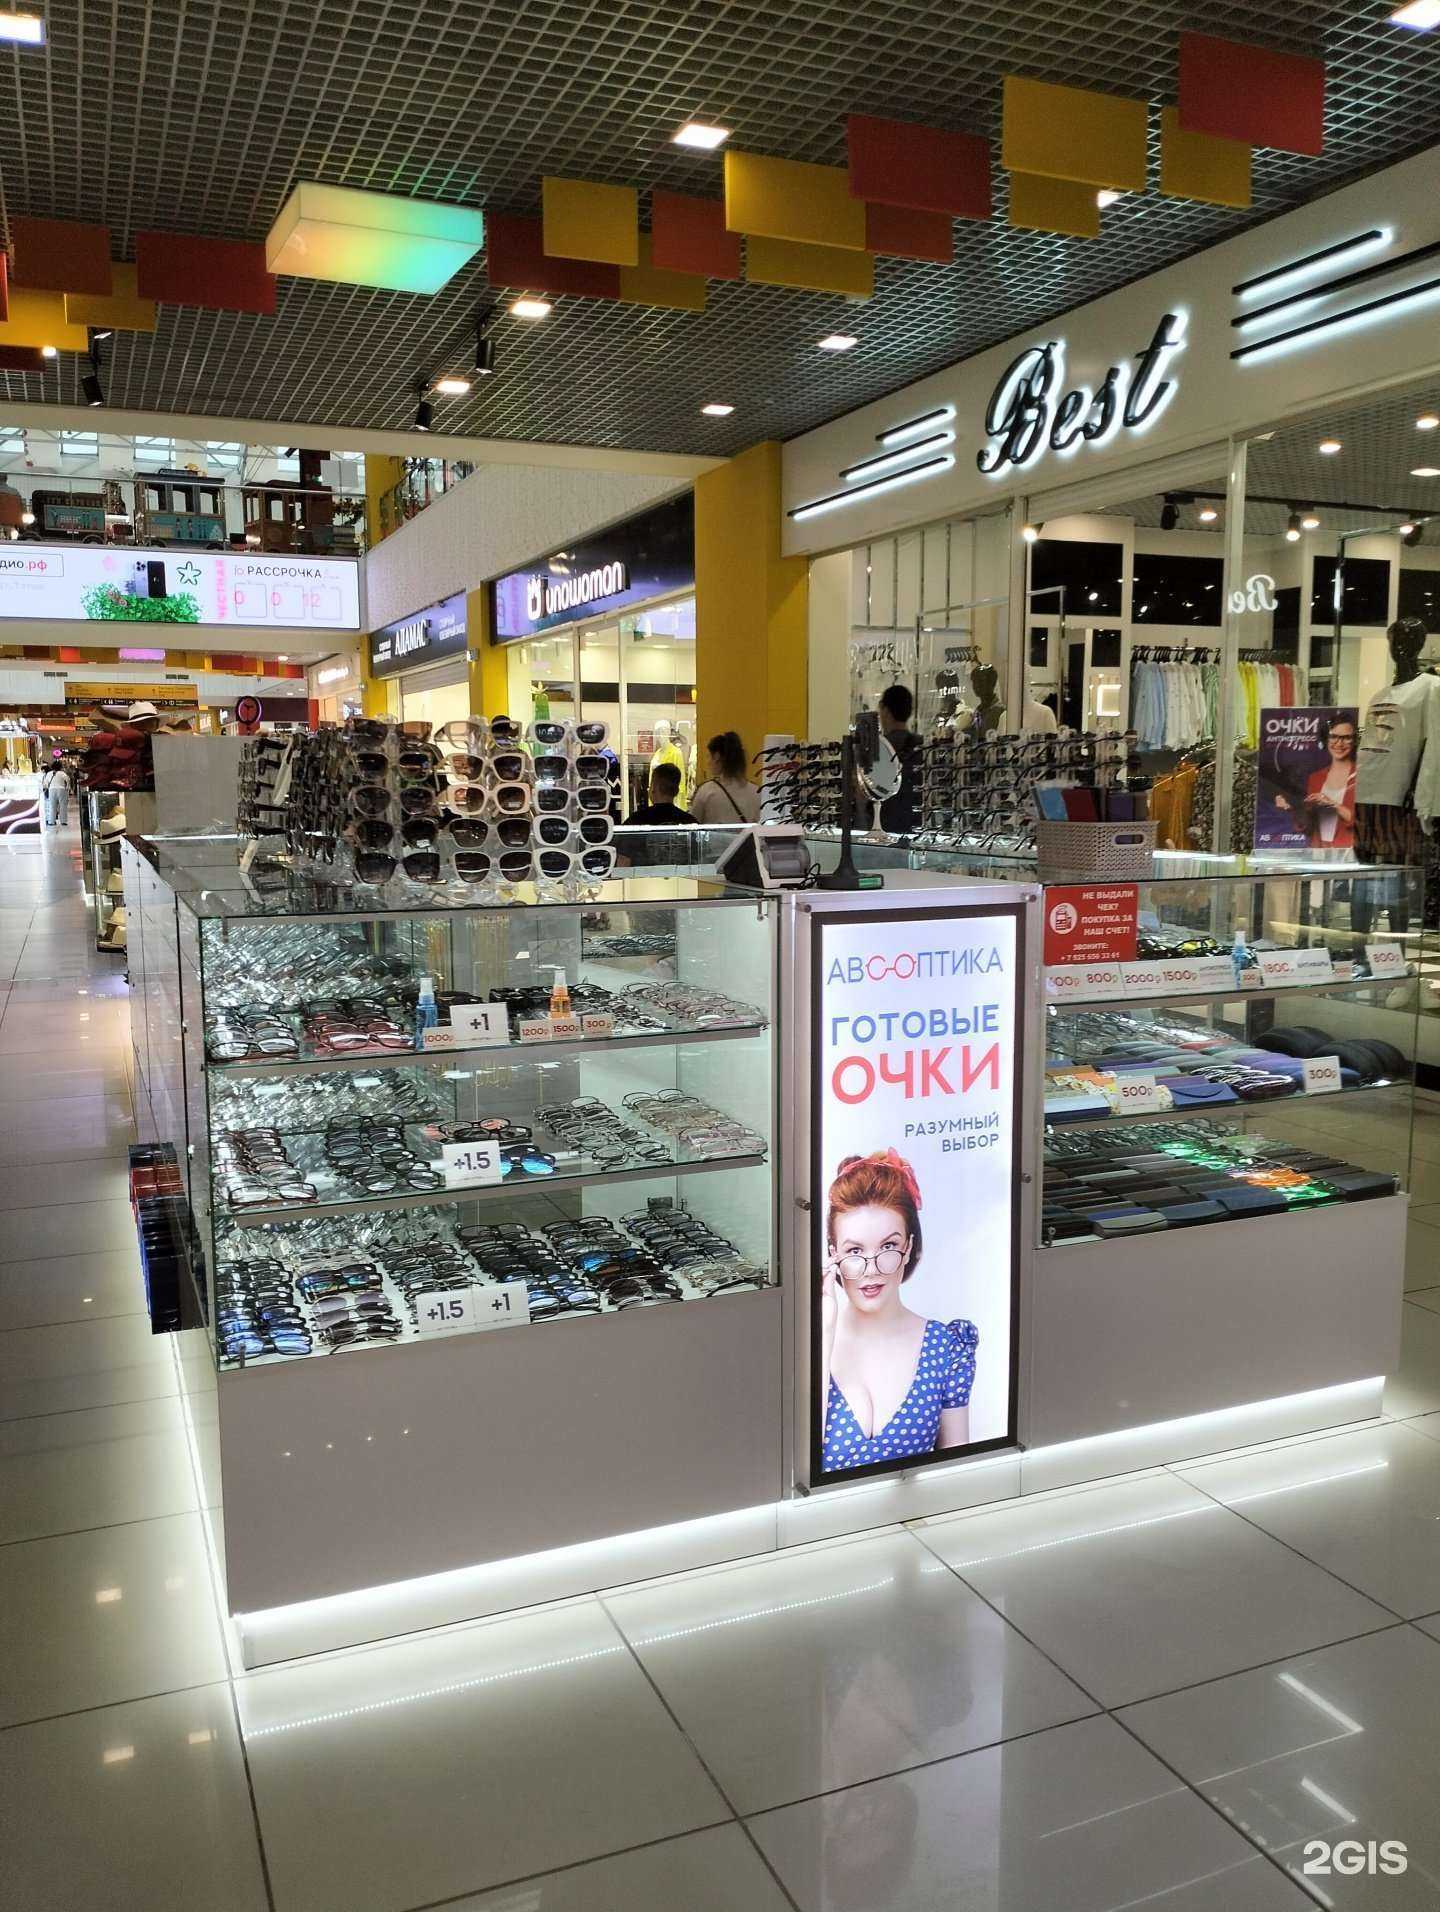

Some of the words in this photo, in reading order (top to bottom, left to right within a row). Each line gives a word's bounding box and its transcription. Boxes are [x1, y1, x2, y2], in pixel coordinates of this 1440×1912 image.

[977, 309, 1188, 477] Best
[247, 565, 322, 579] РАССРОЧКА
[395, 618, 427, 657] АДАМАС
[1266, 717, 1319, 733] ОЧКИ
[1082, 892, 1095, 900] НЕ
[1097, 890, 1134, 899] ВЫДАЛИ
[1081, 915, 1120, 924] ПОКУПКА
[1122, 914, 1133, 922] ЗА
[470, 1013, 489, 1031] +1
[832, 1004, 999, 1046] ГОТОВЫЕ
[832, 1042, 999, 1105] ОЧКИ
[905, 1112, 999, 1138] РАЗУМНЫЙ
[942, 1133, 999, 1153] ВЫБОР
[454, 1151, 490, 1171] +1.5
[427, 1299, 465, 1321] +1.5
[491, 1292, 511, 1311] +1
